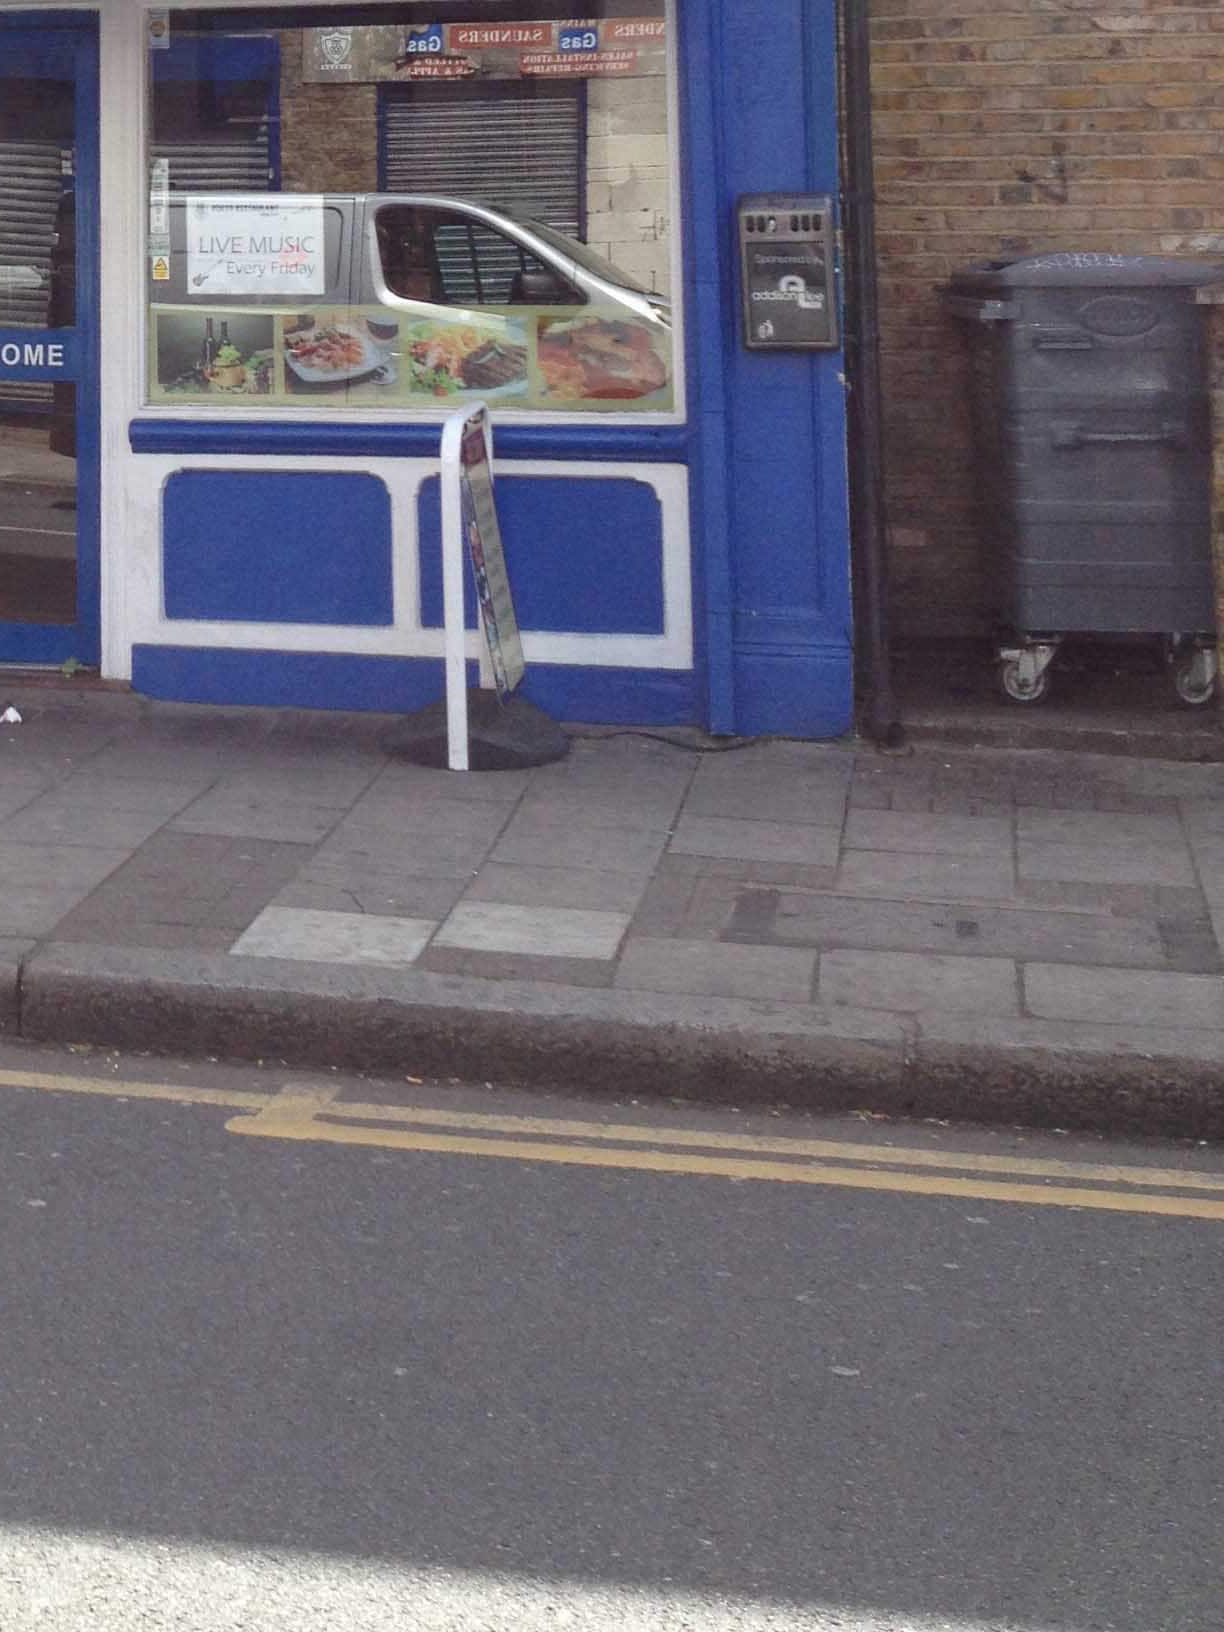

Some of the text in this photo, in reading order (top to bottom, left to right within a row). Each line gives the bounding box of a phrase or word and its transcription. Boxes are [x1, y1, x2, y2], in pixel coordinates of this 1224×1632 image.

[199, 236, 315, 254] LIVE MUSIC
[226, 260, 316, 278] Every Friday
